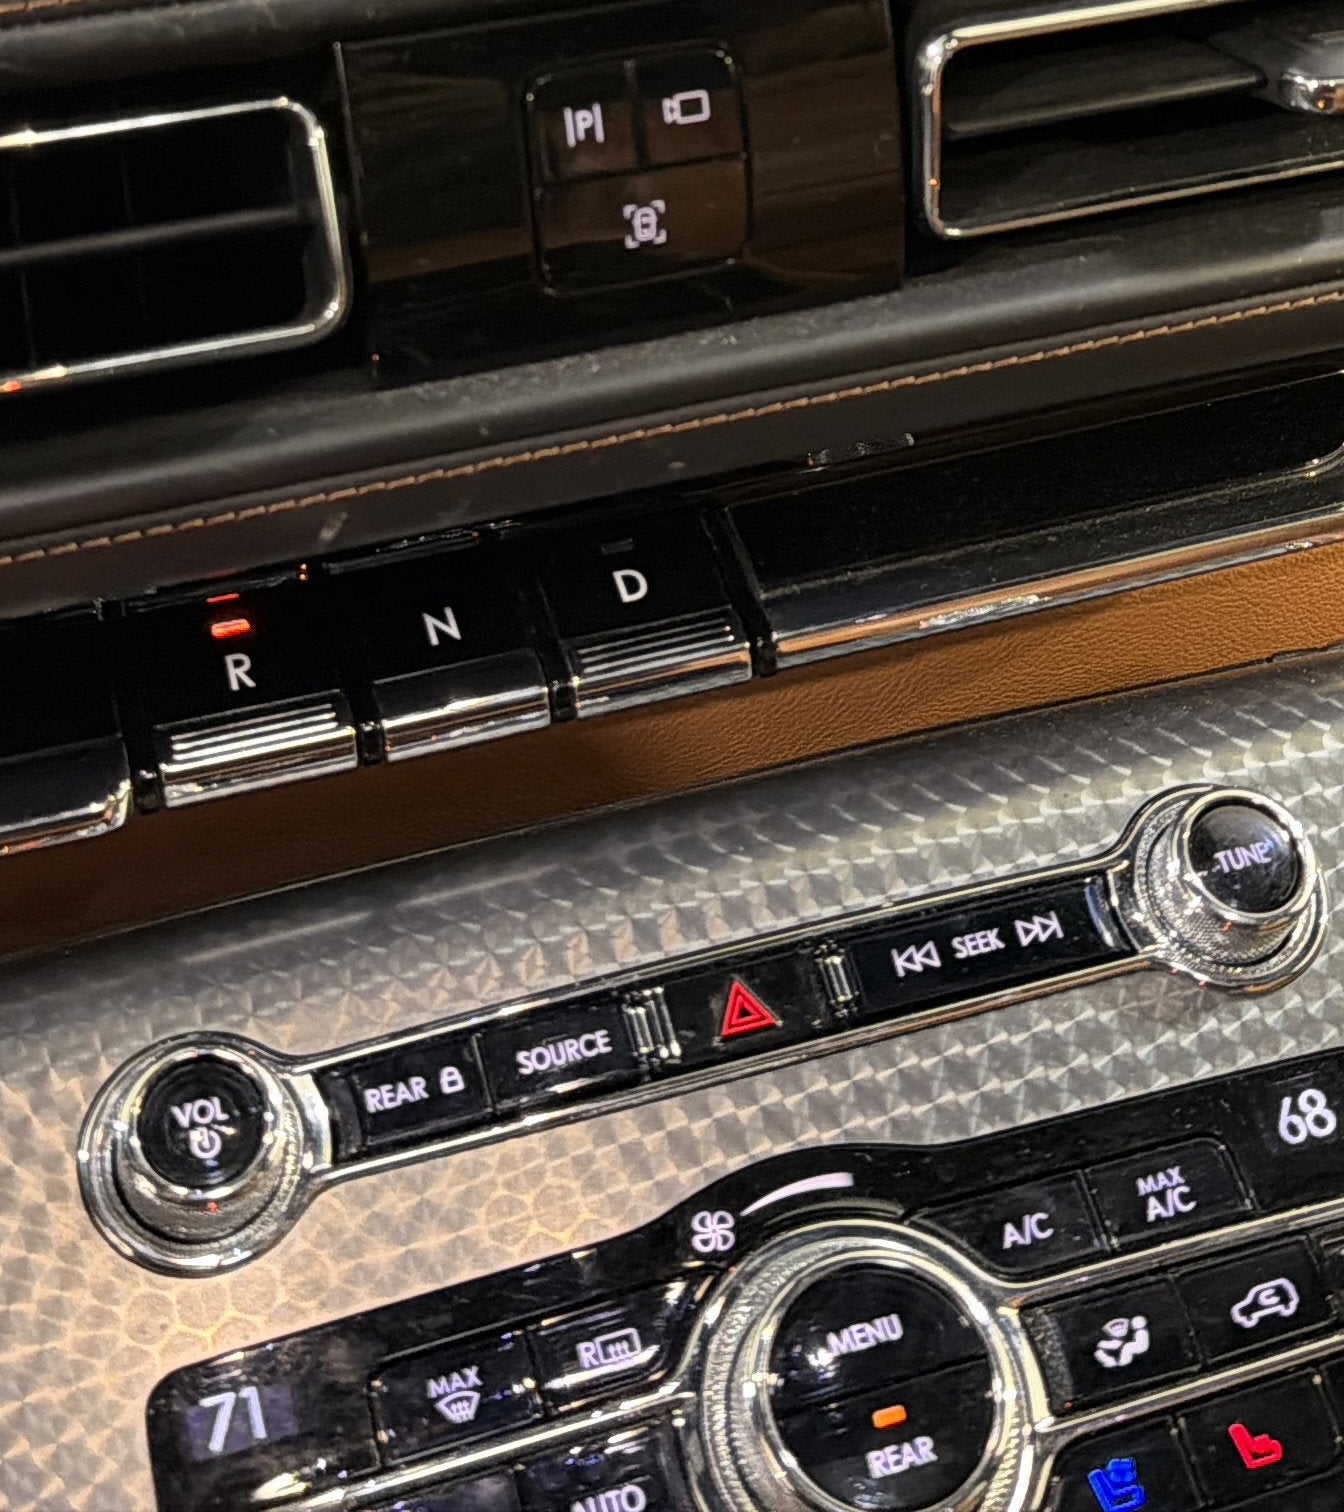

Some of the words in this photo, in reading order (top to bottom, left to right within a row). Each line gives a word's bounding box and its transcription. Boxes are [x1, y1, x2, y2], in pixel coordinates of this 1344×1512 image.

[612, 569, 648, 603] D
[422, 606, 461, 646] N
[224, 653, 256, 691] R
[951, 928, 1005, 959] SEEK
[516, 1029, 613, 1075] SOURCE
[170, 1096, 229, 1129] VOL
[363, 1076, 429, 1113] REAR
[1278, 1088, 1337, 1145] 68
[1136, 1165, 1187, 1197] MAX
[1146, 1184, 1197, 1223] A/C
[1002, 1212, 1054, 1249] A/C
[826, 1313, 904, 1359] MENU
[426, 1365, 484, 1399] MAX
[198, 1385, 268, 1454] 71
[866, 1436, 938, 1479] REAR
